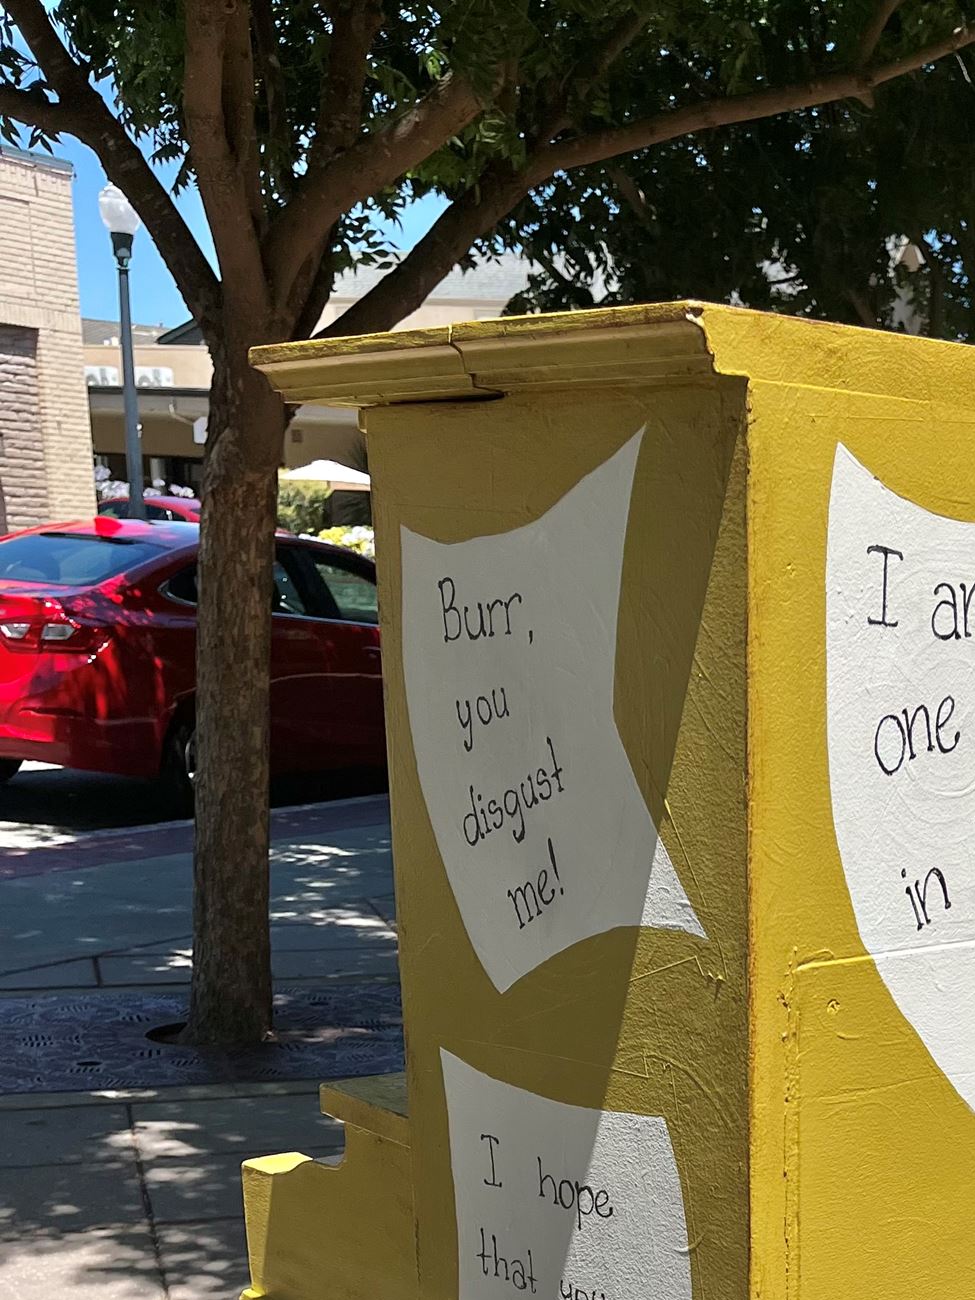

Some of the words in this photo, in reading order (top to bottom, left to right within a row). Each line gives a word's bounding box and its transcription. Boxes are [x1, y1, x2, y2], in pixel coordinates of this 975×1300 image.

[437, 576, 534, 645] Burr,
[867, 544, 904, 627] I
[456, 686, 510, 752] you
[874, 696, 960, 776] one
[463, 736, 565, 847] disgust
[507, 838, 566, 930] me!
[900, 867, 952, 931] in
[480, 1134, 502, 1187] I
[537, 1157, 614, 1230] hope
[476, 1228, 537, 1294] that
